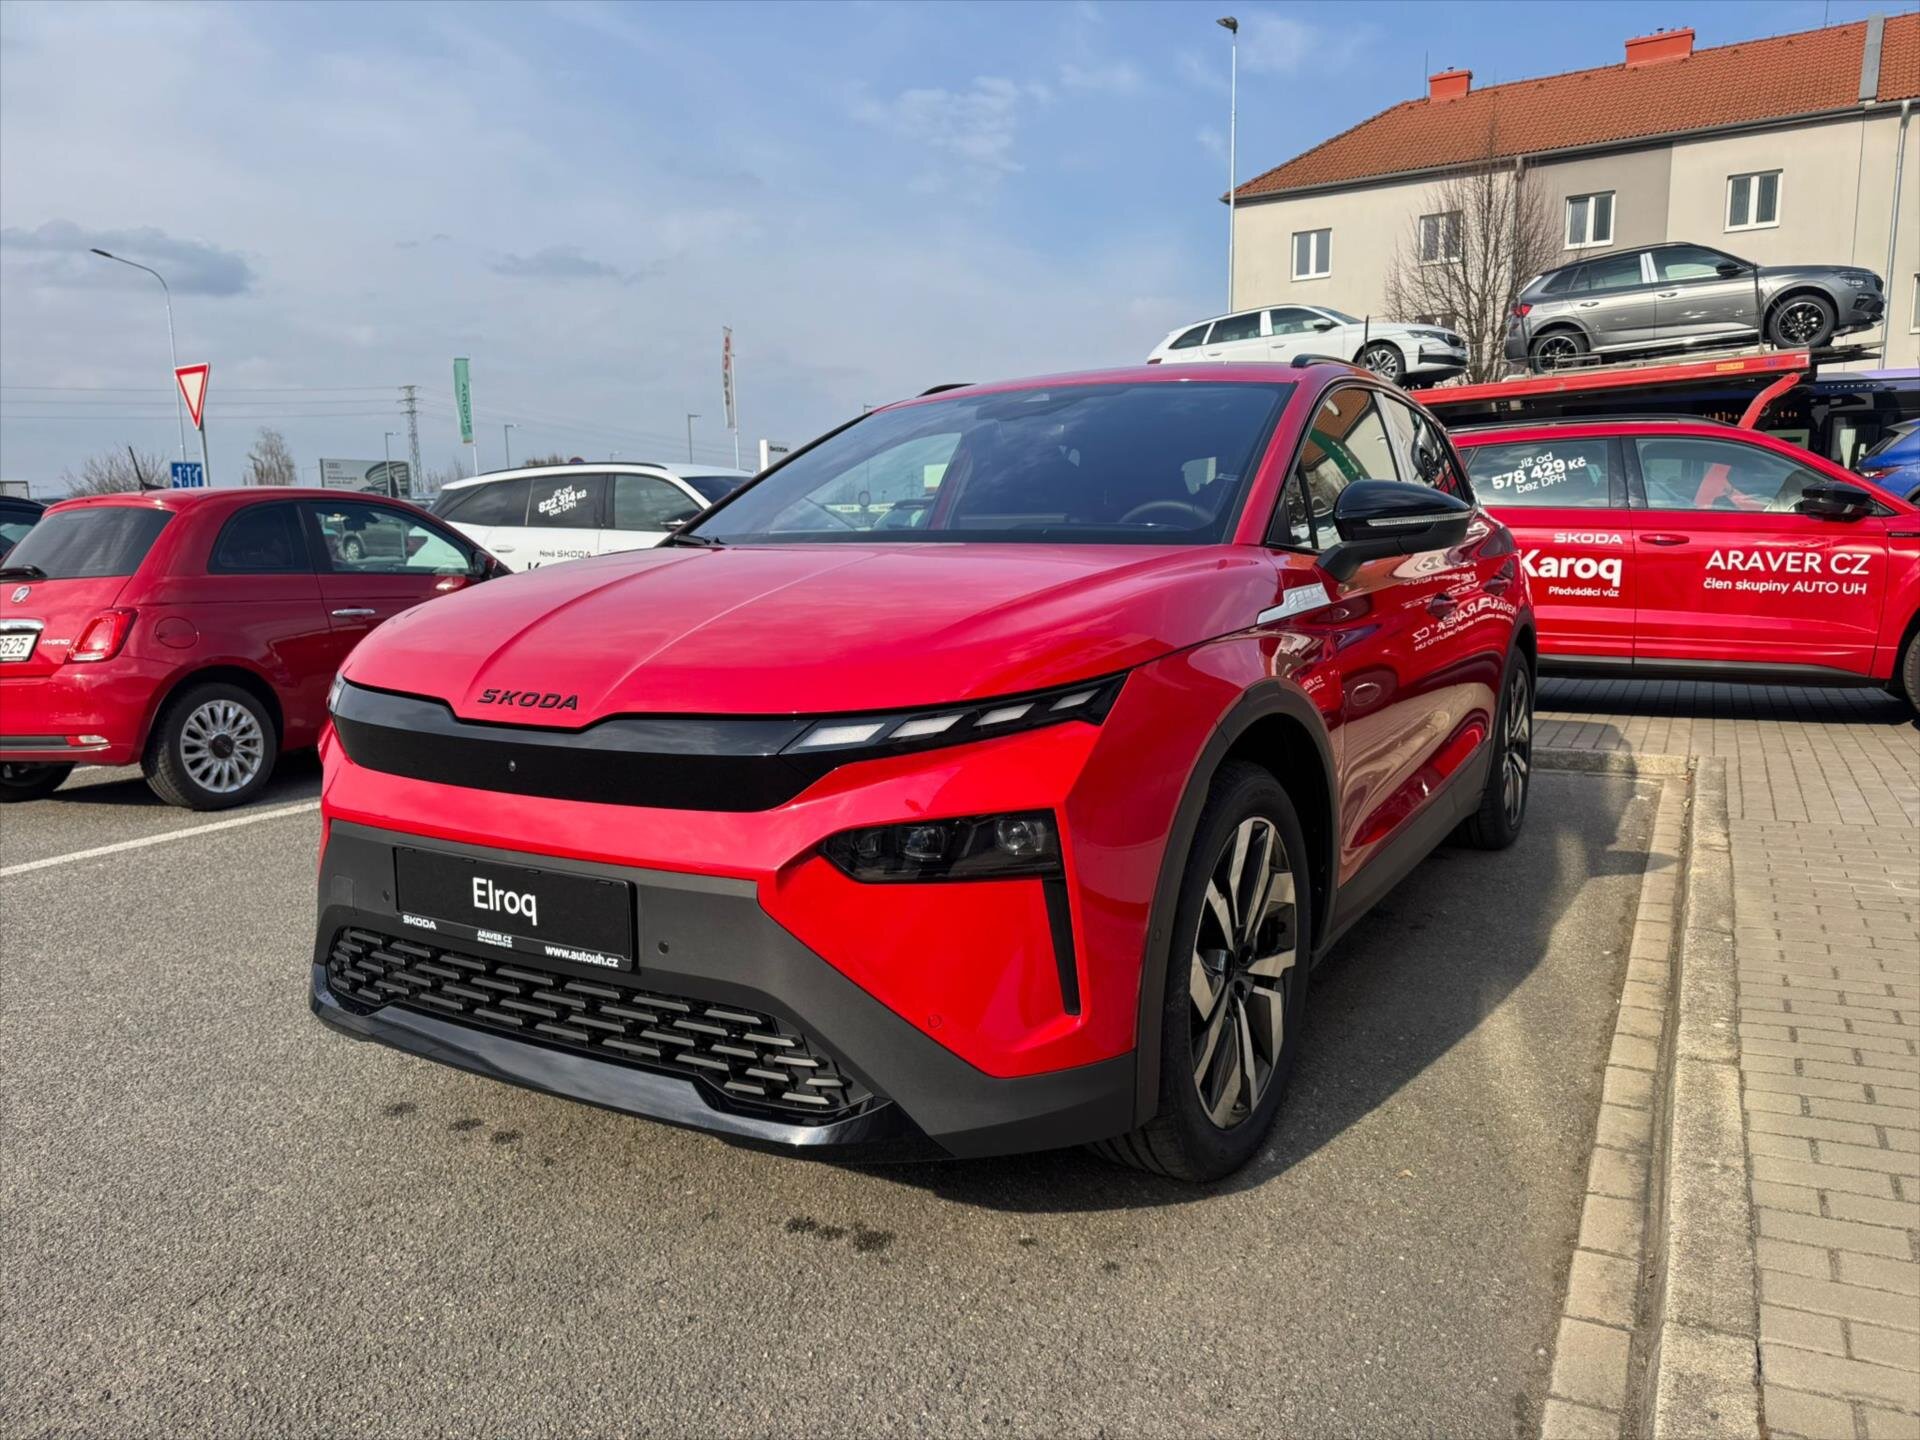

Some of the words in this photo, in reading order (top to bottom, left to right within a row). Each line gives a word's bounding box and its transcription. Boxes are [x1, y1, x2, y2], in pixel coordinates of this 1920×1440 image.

[1518, 456, 1534, 469] Již
[1536, 451, 1553, 464] od
[1492, 470, 1526, 489] 578
[1531, 459, 1565, 479] 429
[1568, 456, 1586, 470] Kč
[1516, 482, 1538, 493] bez
[1541, 473, 1567, 487] DPH
[559, 491, 575, 505] 314
[1519, 549, 1622, 587] Karoq
[1705, 550, 1822, 573] ARAVER
[1830, 553, 1871, 575] CZ
[1549, 586, 1601, 597] Předváděcí
[1602, 588, 1619, 597] vůz
[1703, 577, 1732, 590] člen
[1736, 579, 1790, 594] skupiny
[1792, 581, 1838, 594] AUTO
[1842, 583, 1867, 595] UH
[473, 877, 537, 926] Elroq
[545, 945, 619, 968] www.autouh.cz
